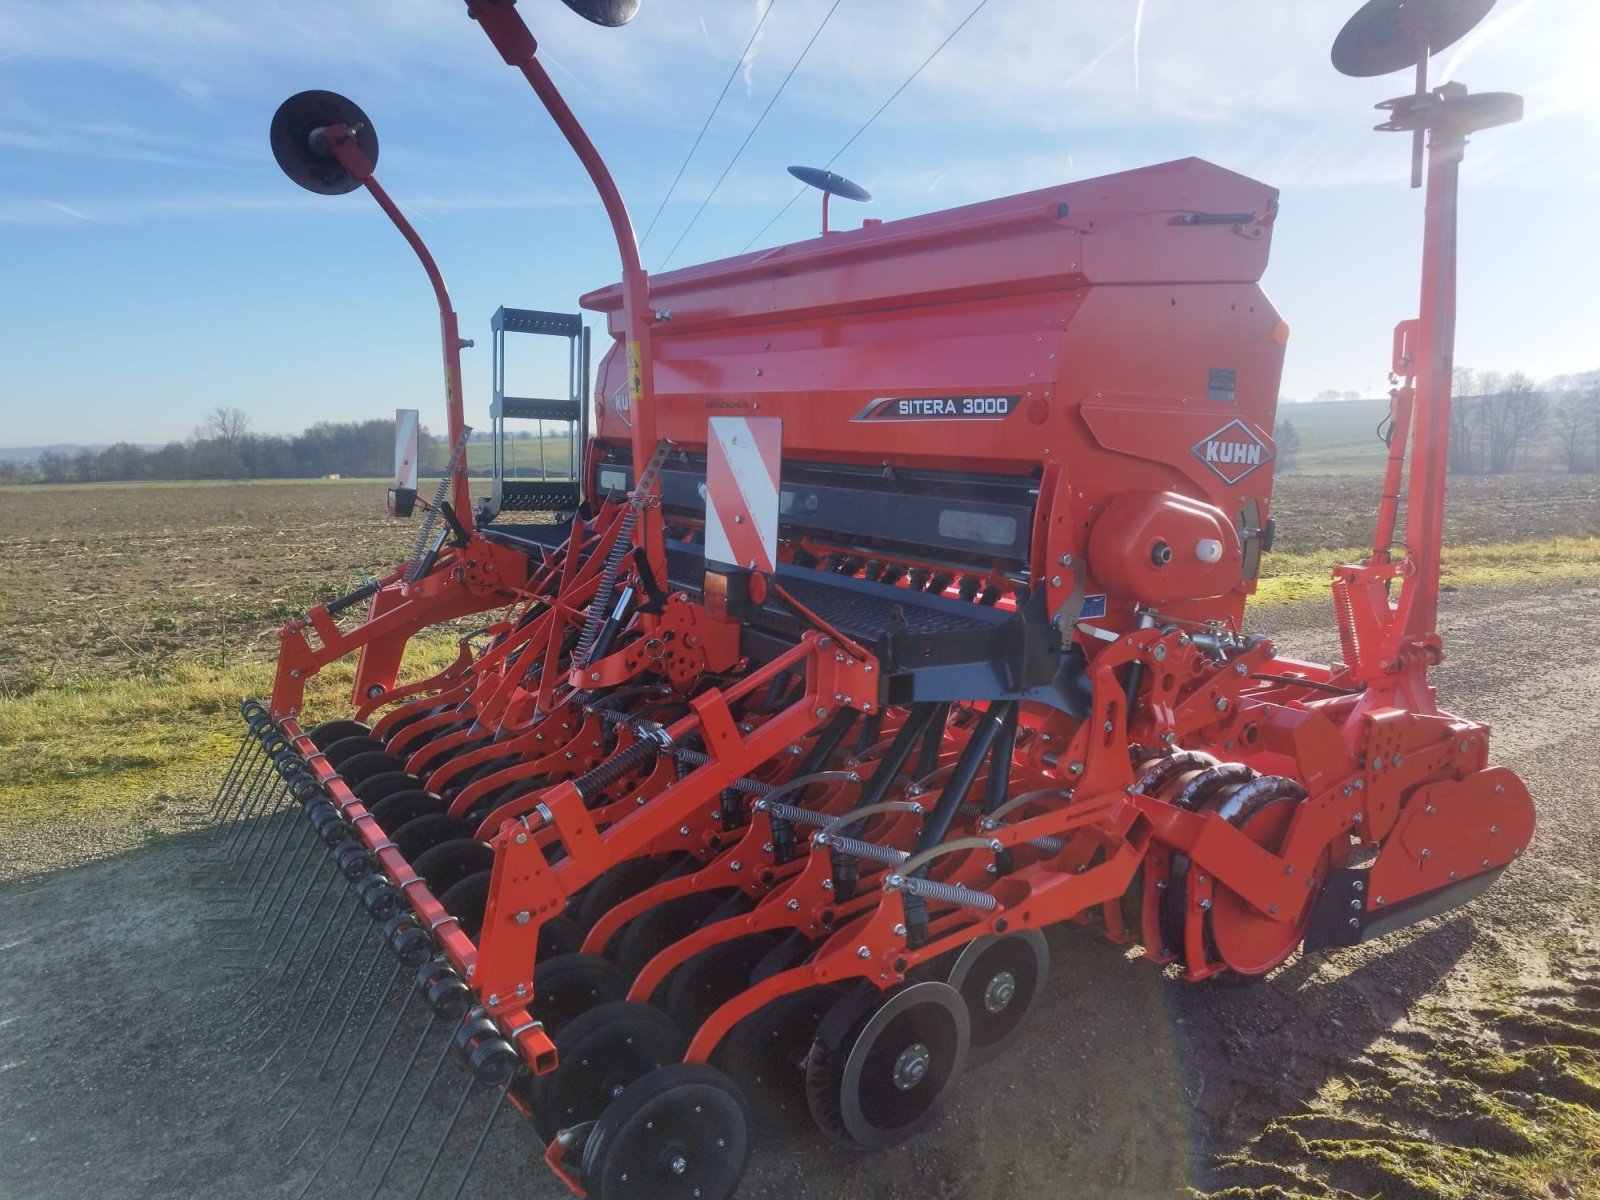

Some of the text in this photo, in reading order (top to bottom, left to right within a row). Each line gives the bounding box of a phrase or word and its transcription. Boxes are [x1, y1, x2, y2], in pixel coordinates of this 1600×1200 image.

[899, 398, 1008, 415] SITERA 3000
[1206, 440, 1261, 465] KUHN
